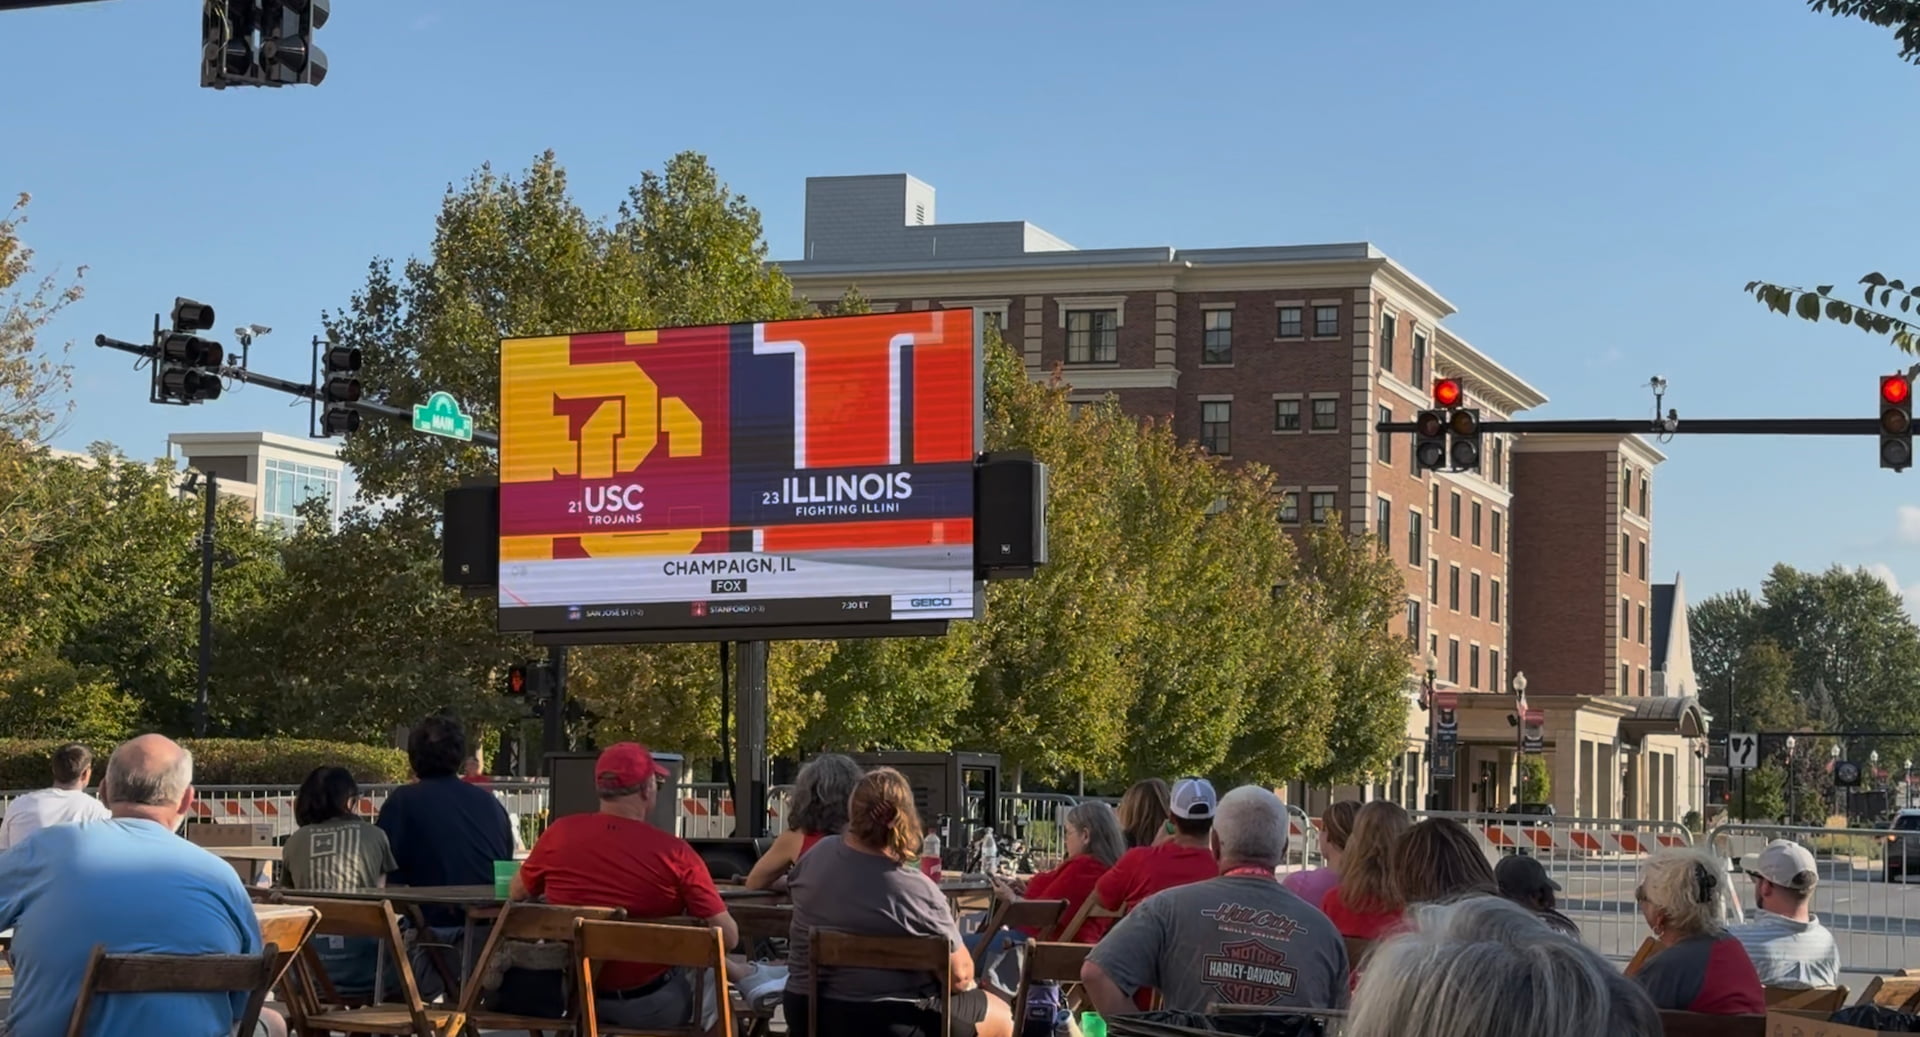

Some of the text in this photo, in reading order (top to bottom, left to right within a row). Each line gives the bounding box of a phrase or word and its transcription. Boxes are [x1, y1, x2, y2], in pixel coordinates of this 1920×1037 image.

[432, 413, 454, 432] MAIN
[762, 472, 912, 504] 23 ILLINOIS
[568, 484, 645, 513] 21 USC
[796, 502, 900, 516] FIGHTING ILLINI
[587, 513, 643, 525] TROJANS
[663, 557, 796, 576] CHAMPAIGN, IL
[716, 580, 741, 592] FOX
[710, 605, 750, 614] STANFORD
[910, 598, 953, 608] GEICO
[586, 609, 601, 617] SAN
[620, 608, 630, 617] ST
[1209, 961, 1293, 988] HARLEY-DAVIDSON
